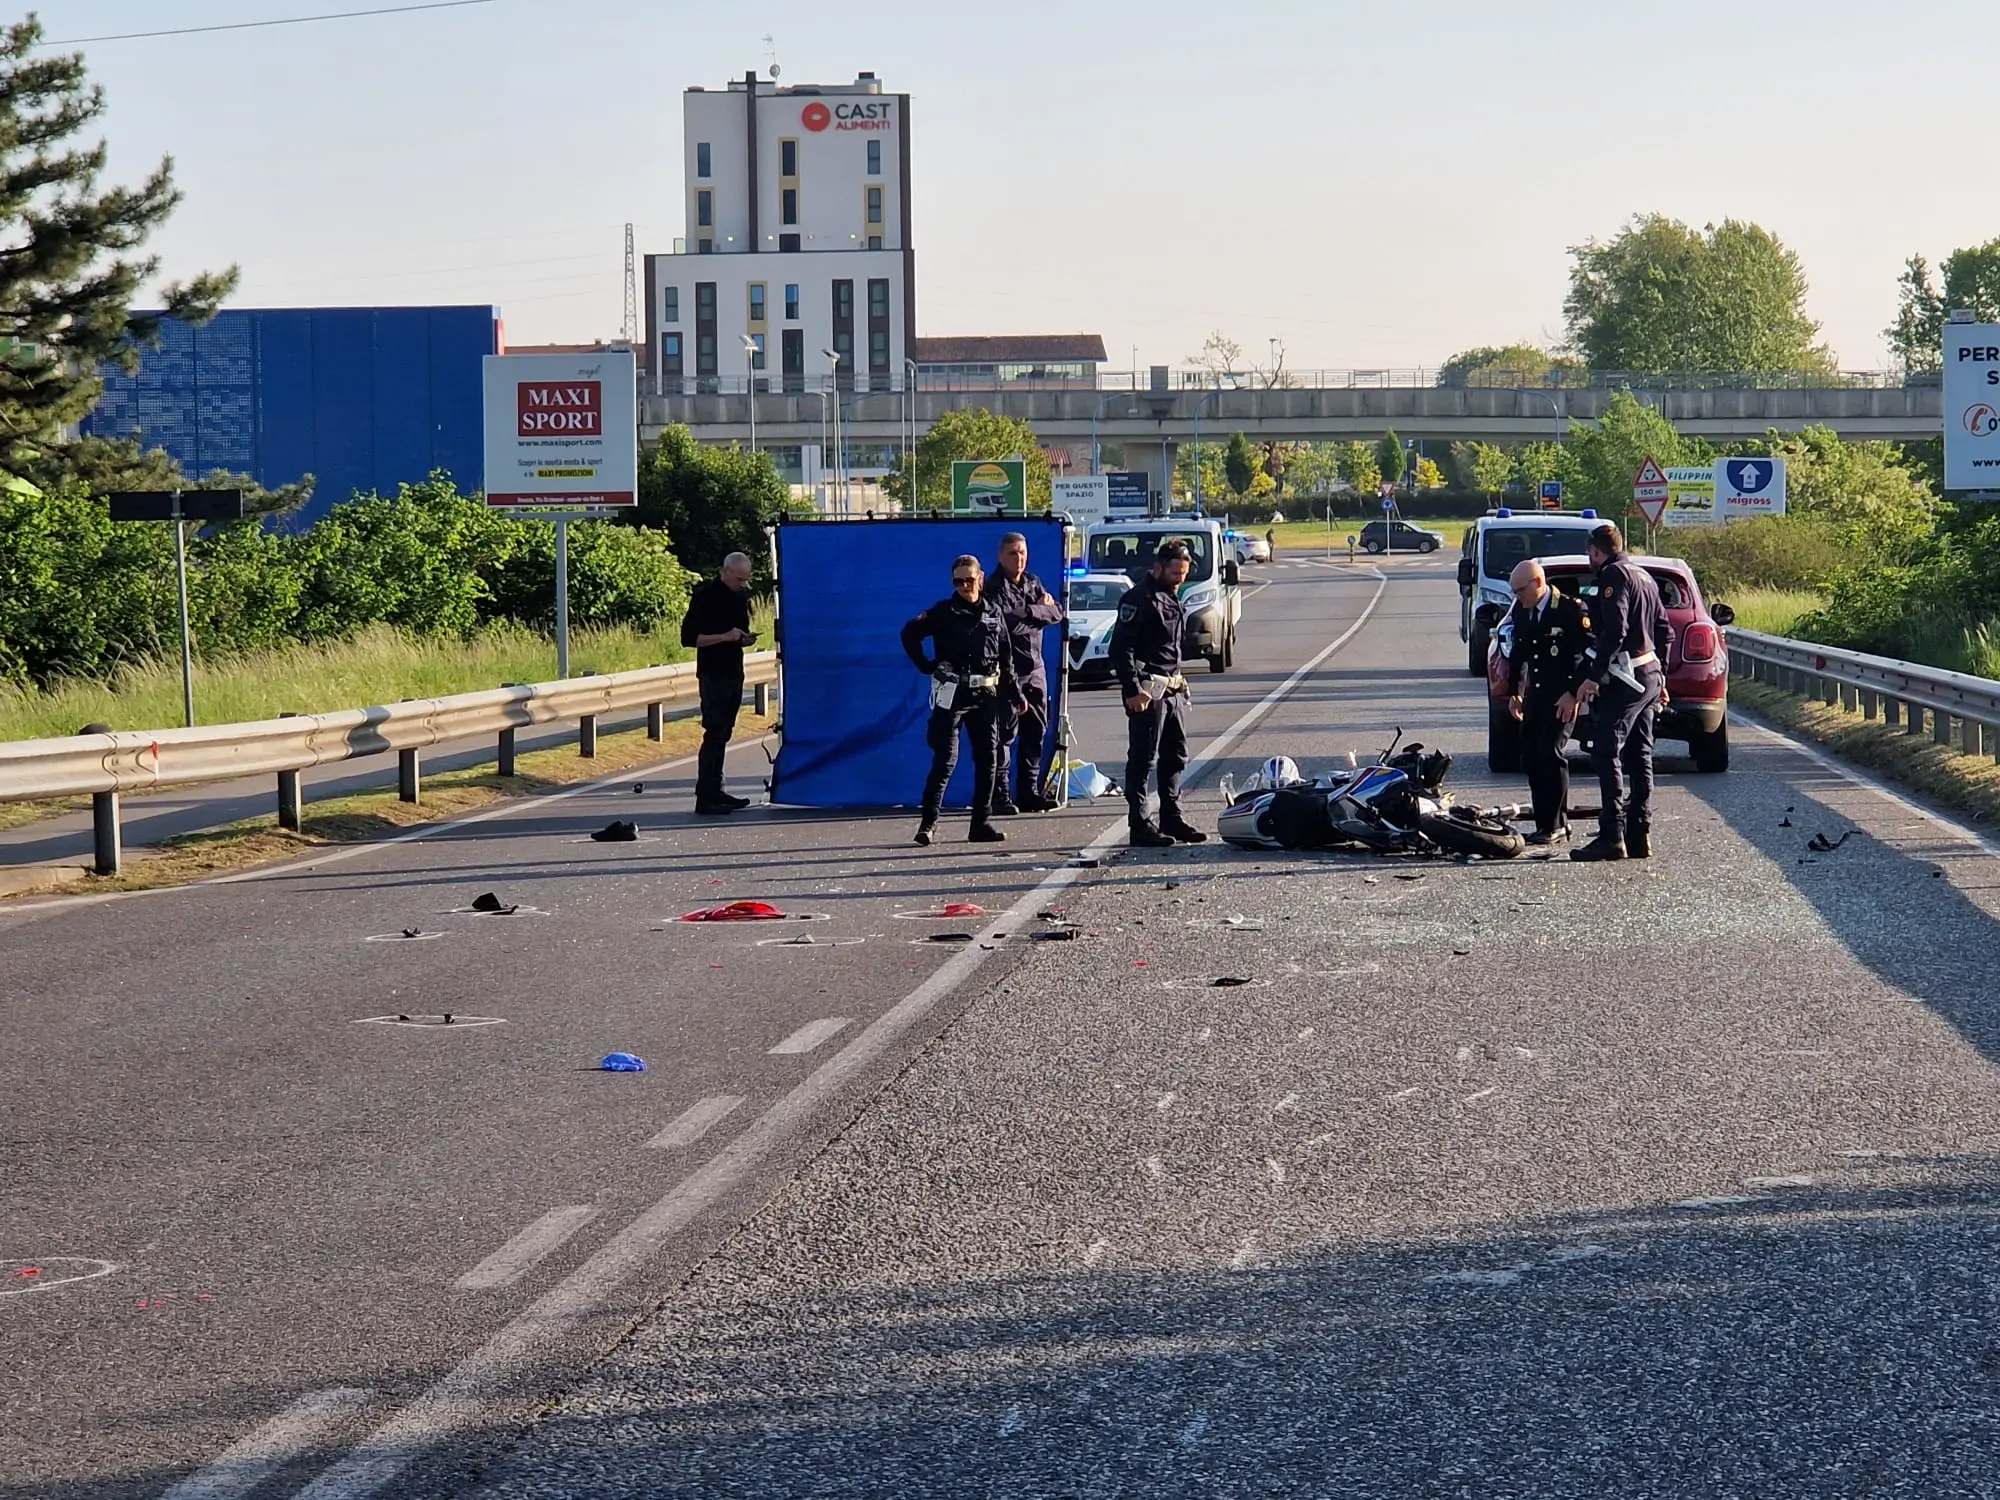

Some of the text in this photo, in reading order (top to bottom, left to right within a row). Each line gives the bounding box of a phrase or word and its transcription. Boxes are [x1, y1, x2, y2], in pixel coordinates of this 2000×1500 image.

[835, 103, 891, 120] CAST
[835, 120, 890, 131] ALIMENTI
[1958, 346, 2000, 362] PER
[528, 388, 591, 406] MAXI
[522, 411, 598, 431] SPORT
[517, 438, 603, 448] www.maxisport.com
[1668, 471, 1713, 480] FILIPPIN
[1055, 482, 1071, 490] PER
[1065, 490, 1095, 498] SPAZIO
[1640, 488, 1654, 496] 150
